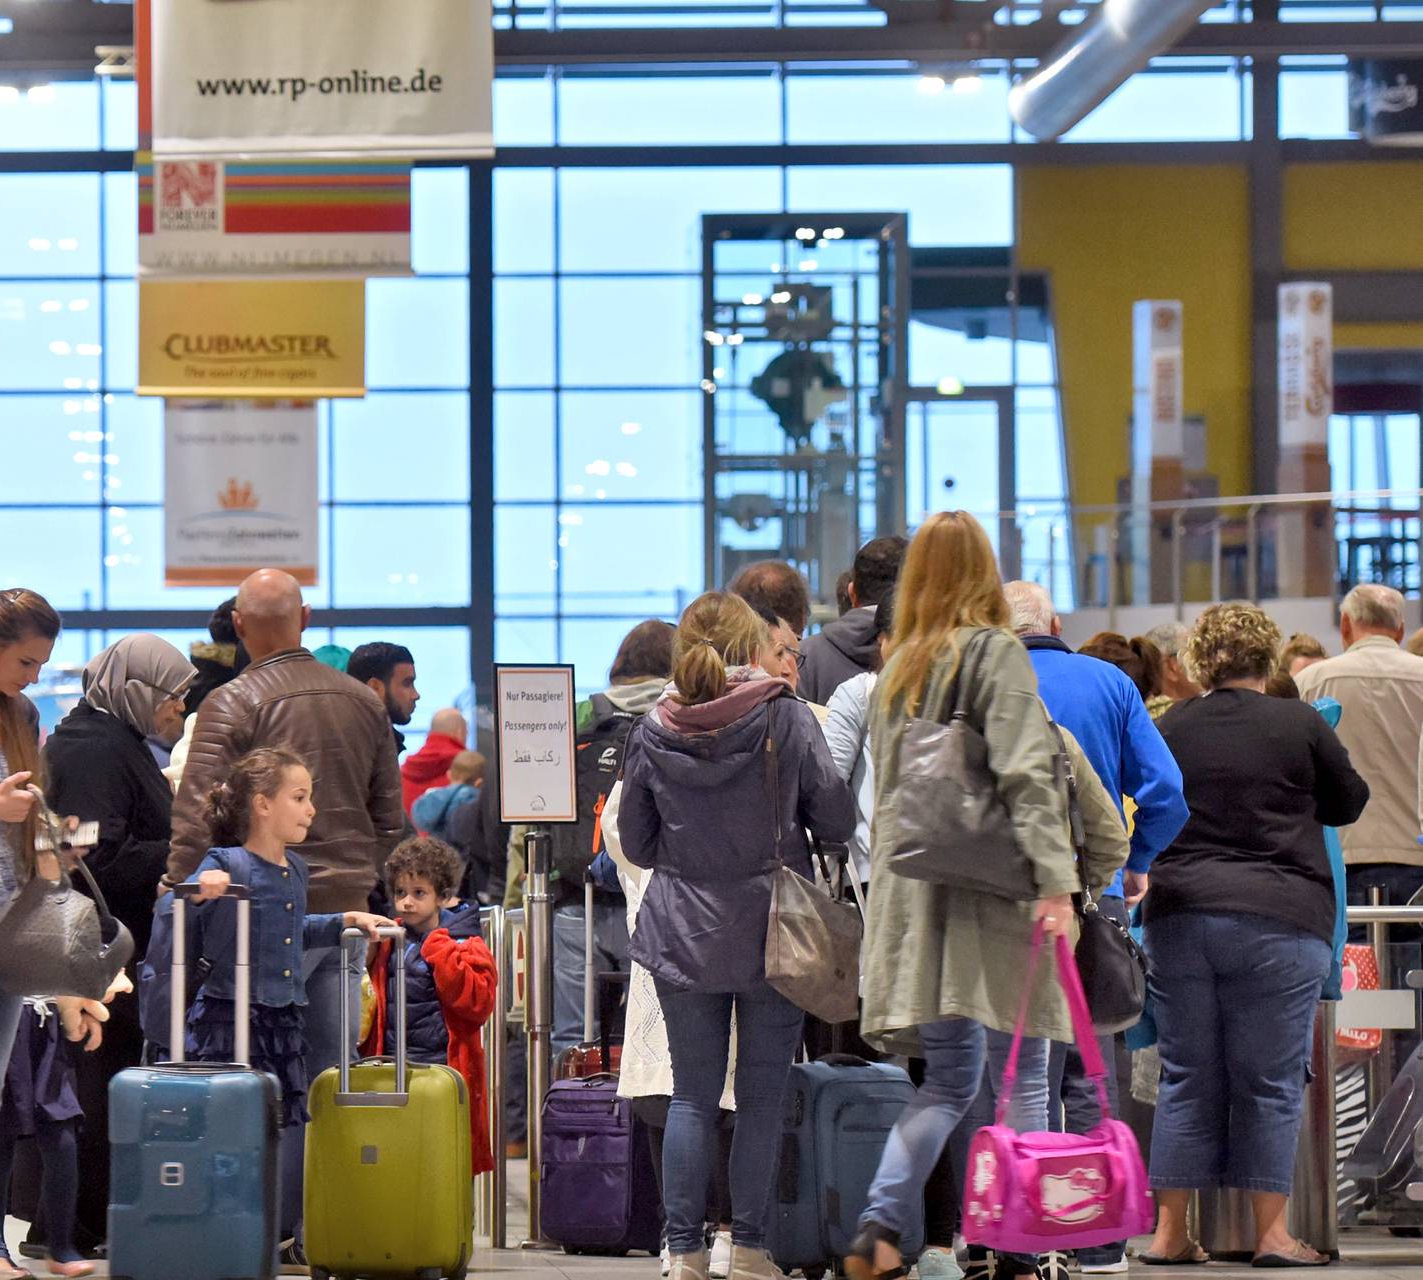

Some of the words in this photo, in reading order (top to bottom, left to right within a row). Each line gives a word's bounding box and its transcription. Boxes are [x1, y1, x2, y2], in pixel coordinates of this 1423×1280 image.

[196, 69, 442, 101] www.rp-online.de
[506, 691, 519, 700] Nur
[521, 691, 564, 703] Passagiere!
[504, 720, 547, 733] Passengers
[548, 720, 568, 733] only!
[513, 750, 531, 763] فقط
[534, 750, 561, 767] ركاب
